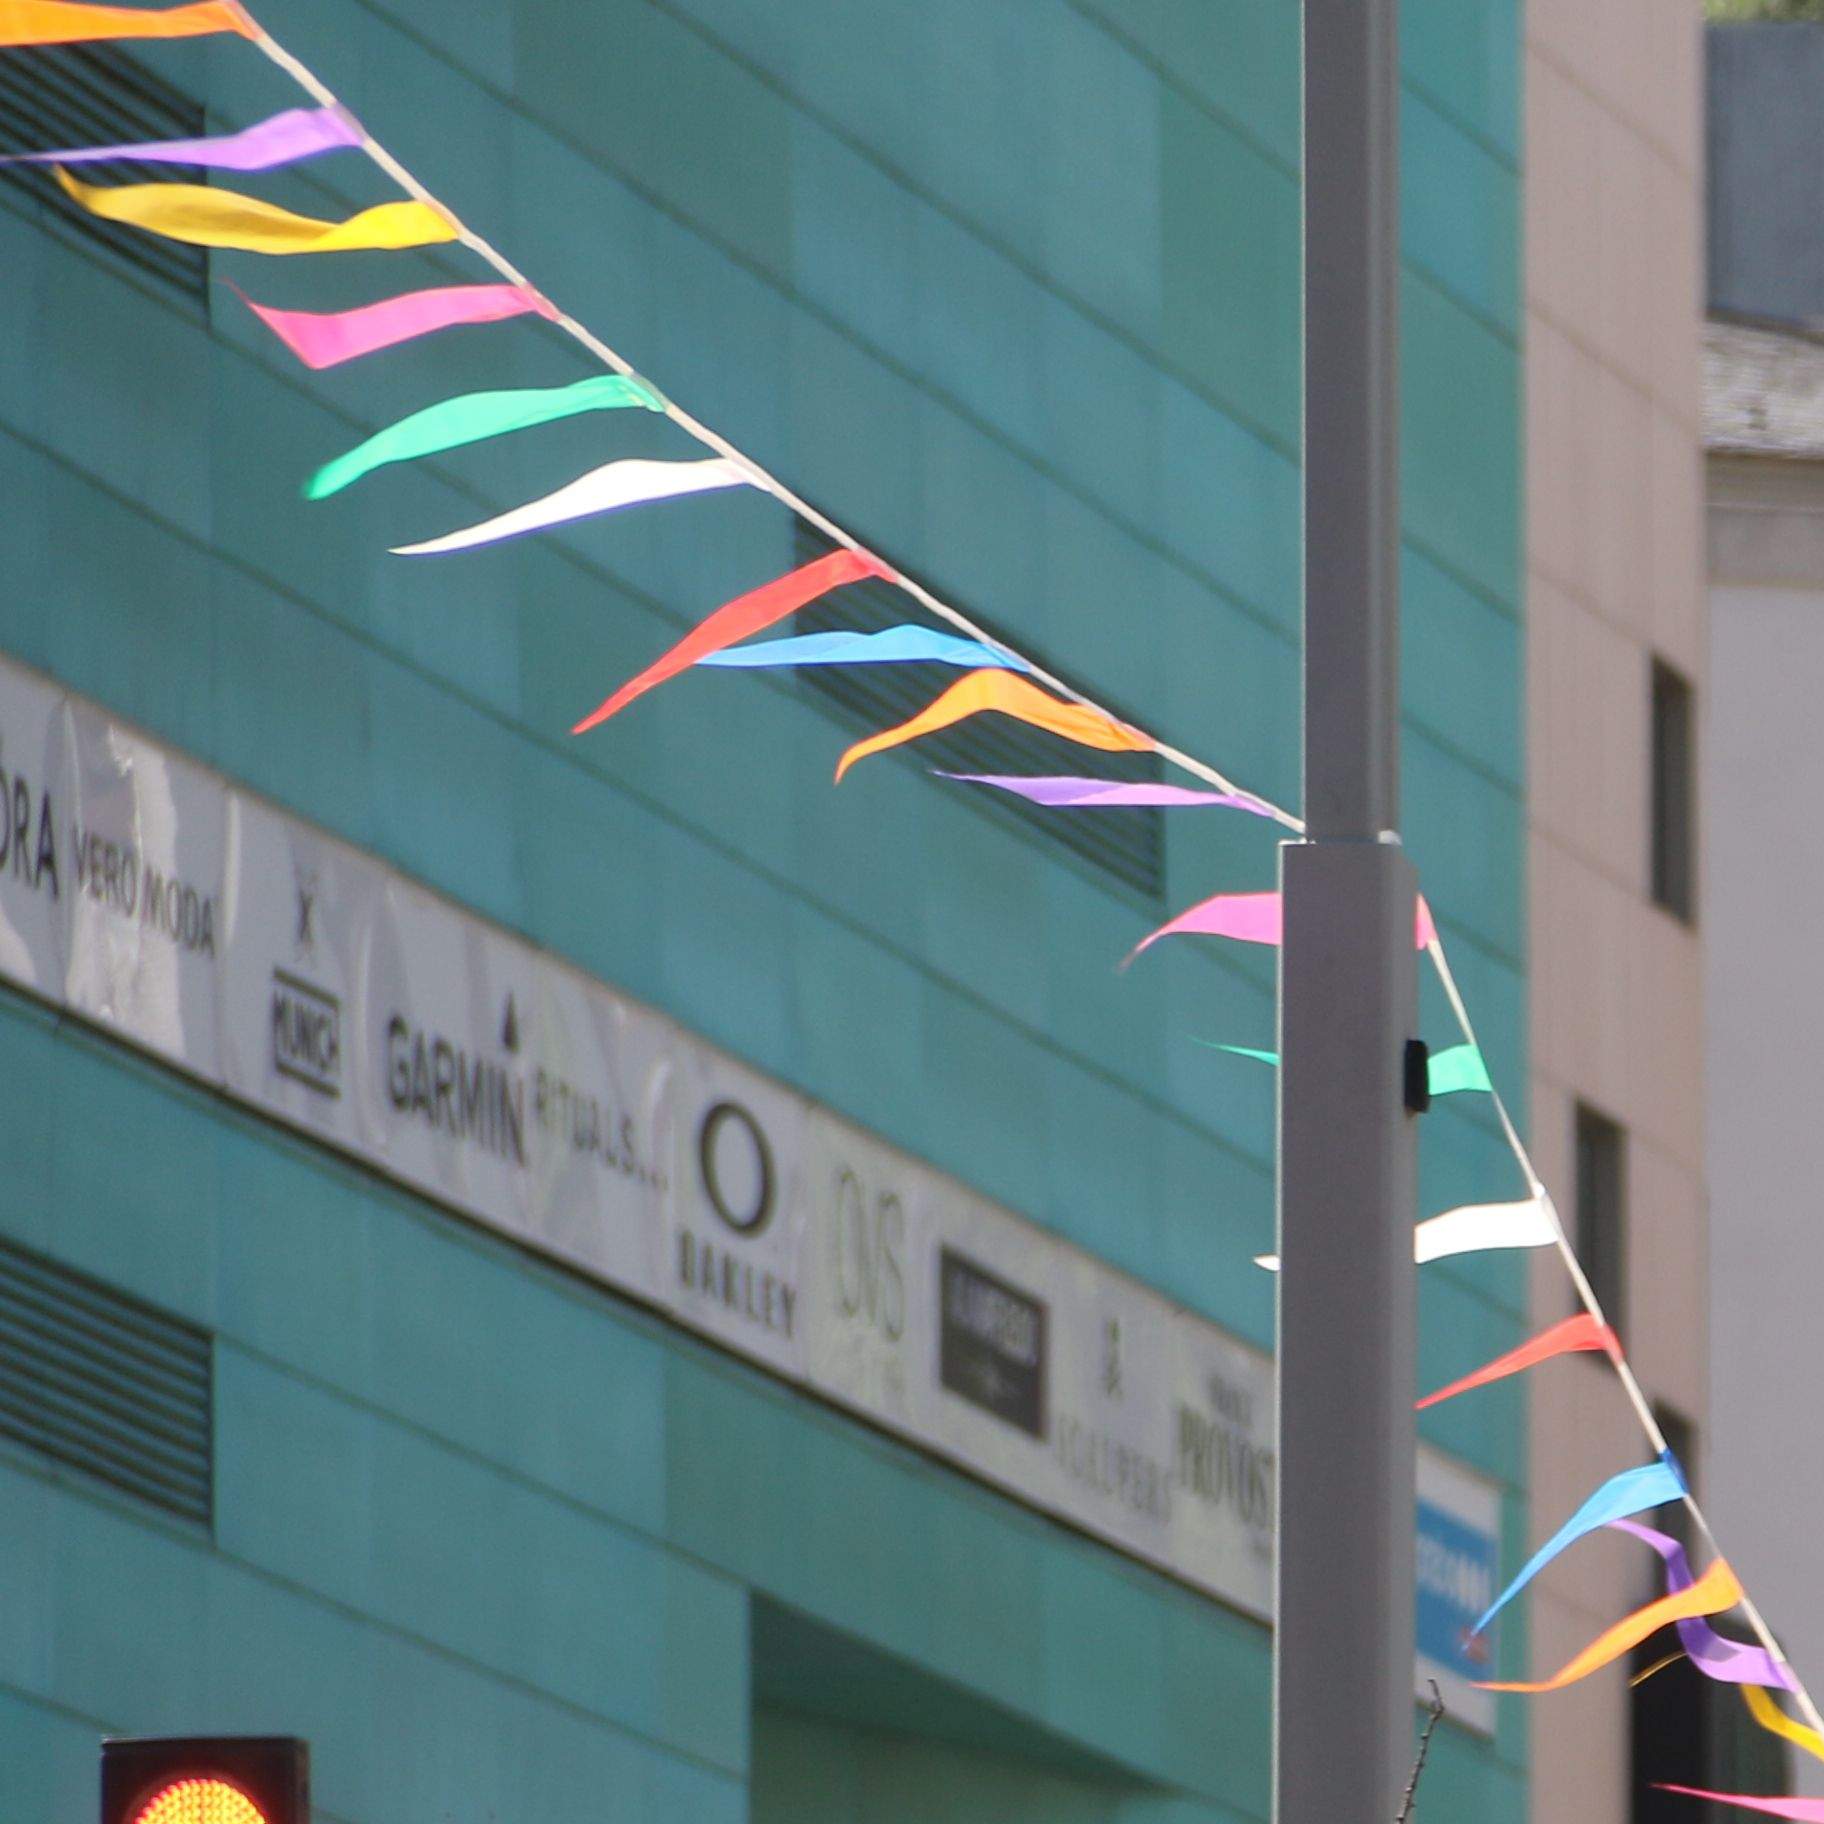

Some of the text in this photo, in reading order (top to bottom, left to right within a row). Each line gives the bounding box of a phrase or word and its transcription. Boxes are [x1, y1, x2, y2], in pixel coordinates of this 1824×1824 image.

[72, 825, 215, 959] VERO MODA
[388, 1014, 525, 1169] GARMIN
[677, 1229, 797, 1341] OAKLEY
